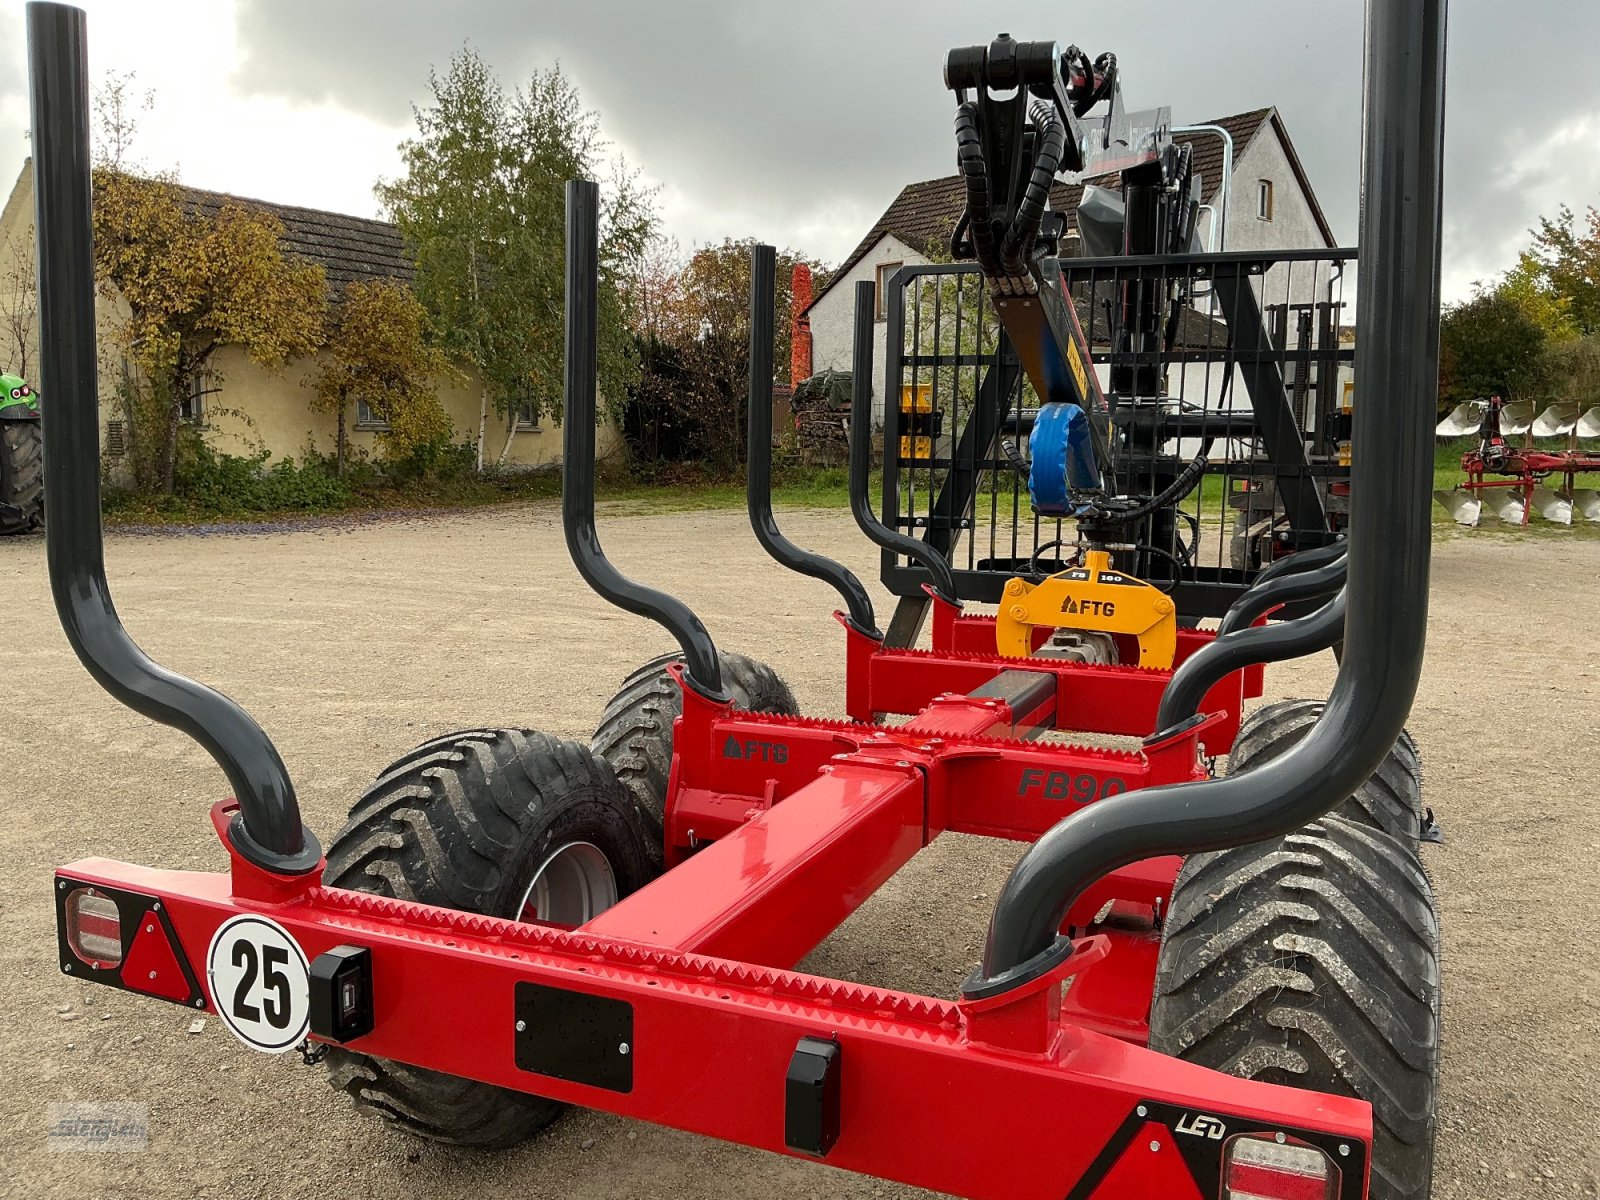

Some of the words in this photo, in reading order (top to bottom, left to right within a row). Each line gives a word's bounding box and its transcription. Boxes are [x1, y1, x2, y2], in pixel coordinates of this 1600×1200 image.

[1101, 574, 1122, 582] 160
[1080, 599, 1115, 617] FTG
[745, 741, 789, 764] FTG
[1018, 768, 1126, 803] FB90
[231, 938, 292, 1030] 25
[1175, 1113, 1226, 1140] LED
